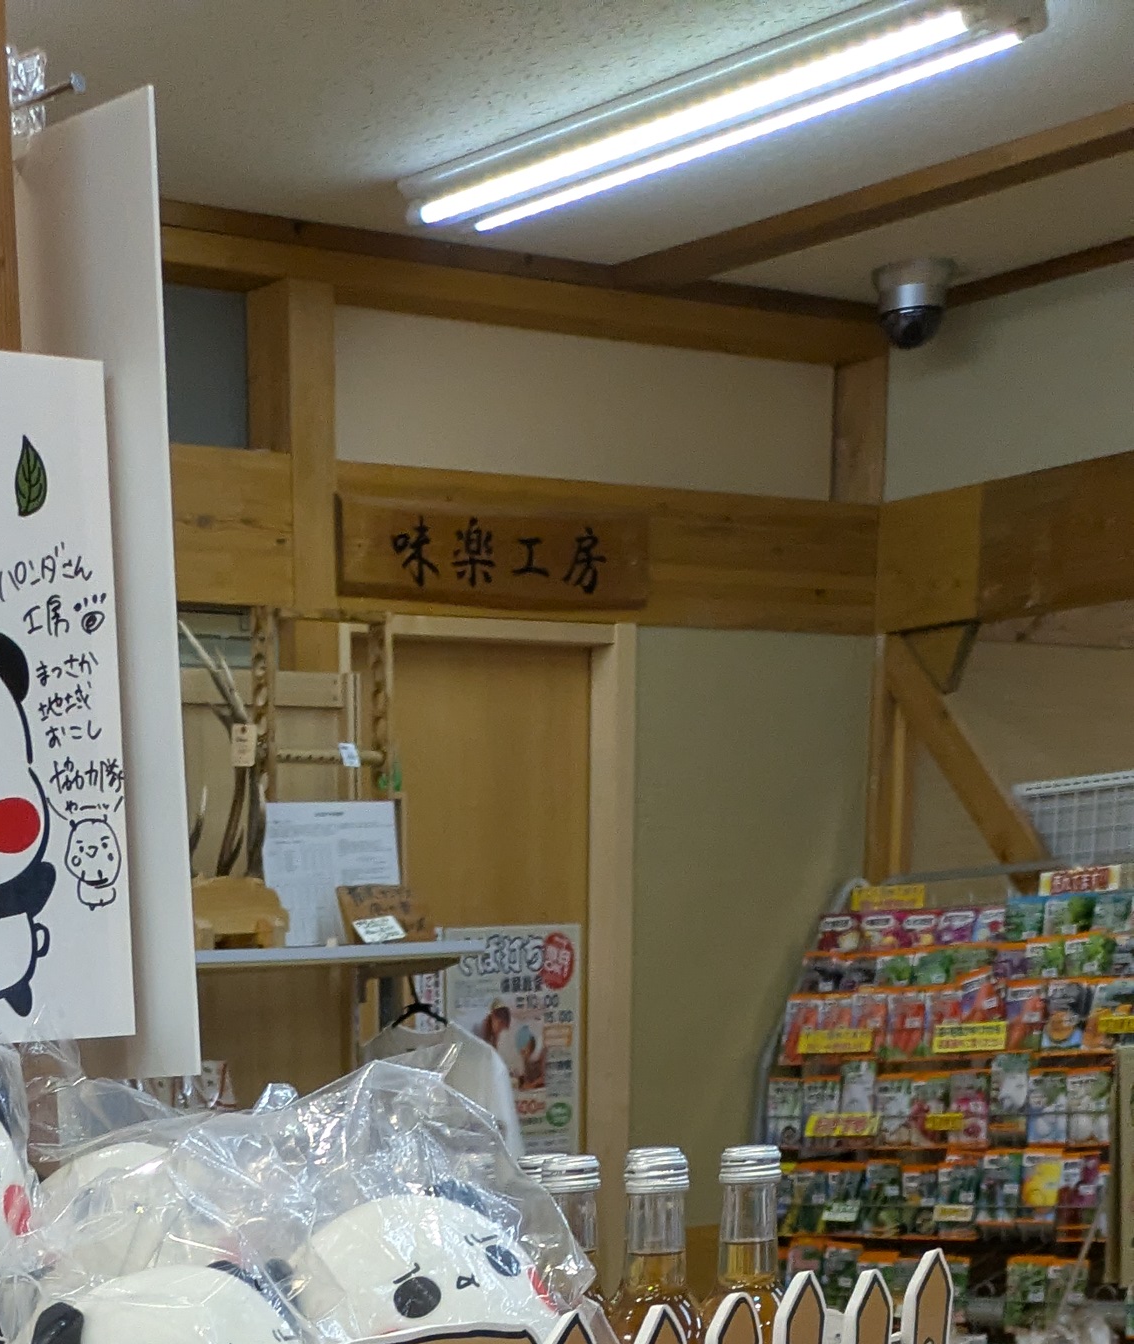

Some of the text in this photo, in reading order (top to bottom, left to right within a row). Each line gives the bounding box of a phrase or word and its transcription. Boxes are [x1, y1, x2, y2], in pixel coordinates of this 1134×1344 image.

[390, 515, 607, 595] 味楽工房
[24, 594, 70, 637] 工房
[45, 720, 102, 749] おこし
